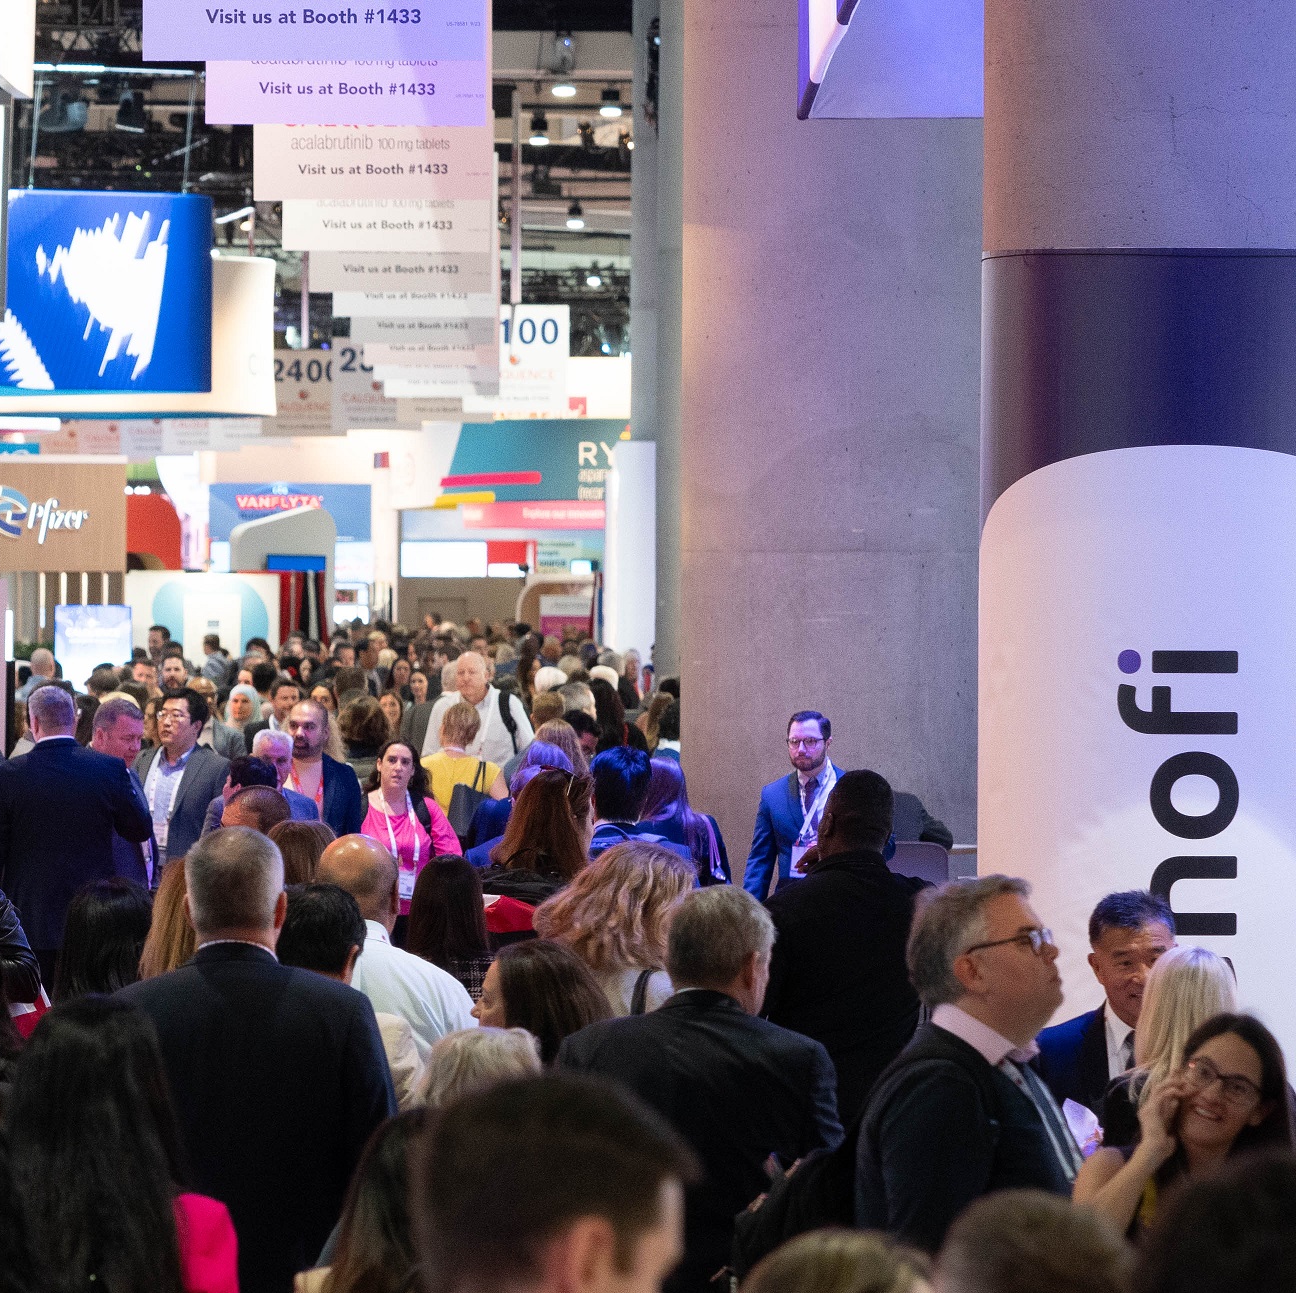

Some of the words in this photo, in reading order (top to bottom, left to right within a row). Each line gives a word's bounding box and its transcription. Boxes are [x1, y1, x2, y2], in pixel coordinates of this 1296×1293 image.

[205, 8, 246, 24] Visit
[252, 12, 272, 24] us
[278, 10, 296, 24] at
[303, 8, 358, 24] Booth
[364, 8, 422, 24] #1433
[258, 82, 292, 95] Visit
[297, 85, 314, 95] us
[318, 84, 334, 95] at
[338, 82, 383, 95] Booth
[389, 82, 436, 95] #1433
[291, 134, 374, 150] acalabrutinib
[378, 138, 395, 150] 100
[397, 140, 414, 152] mg
[416, 138, 450, 150] tablets
[298, 164, 326, 175] Visit
[330, 167, 344, 175] us
[348, 165, 361, 175] at
[366, 164, 404, 175] Booth
[408, 164, 448, 175] #1433
[322, 220, 346, 230] Visit
[350, 222, 362, 230] us
[366, 221, 377, 230] at
[380, 220, 414, 230] Booth
[418, 220, 453, 230] #1433
[342, 264, 365, 274] Visit
[368, 266, 378, 274] us
[382, 265, 392, 274] at
[395, 264, 425, 274] Booth
[235, 494, 321, 511] VANFLYTA
[27, 497, 83, 545] Pfizer
